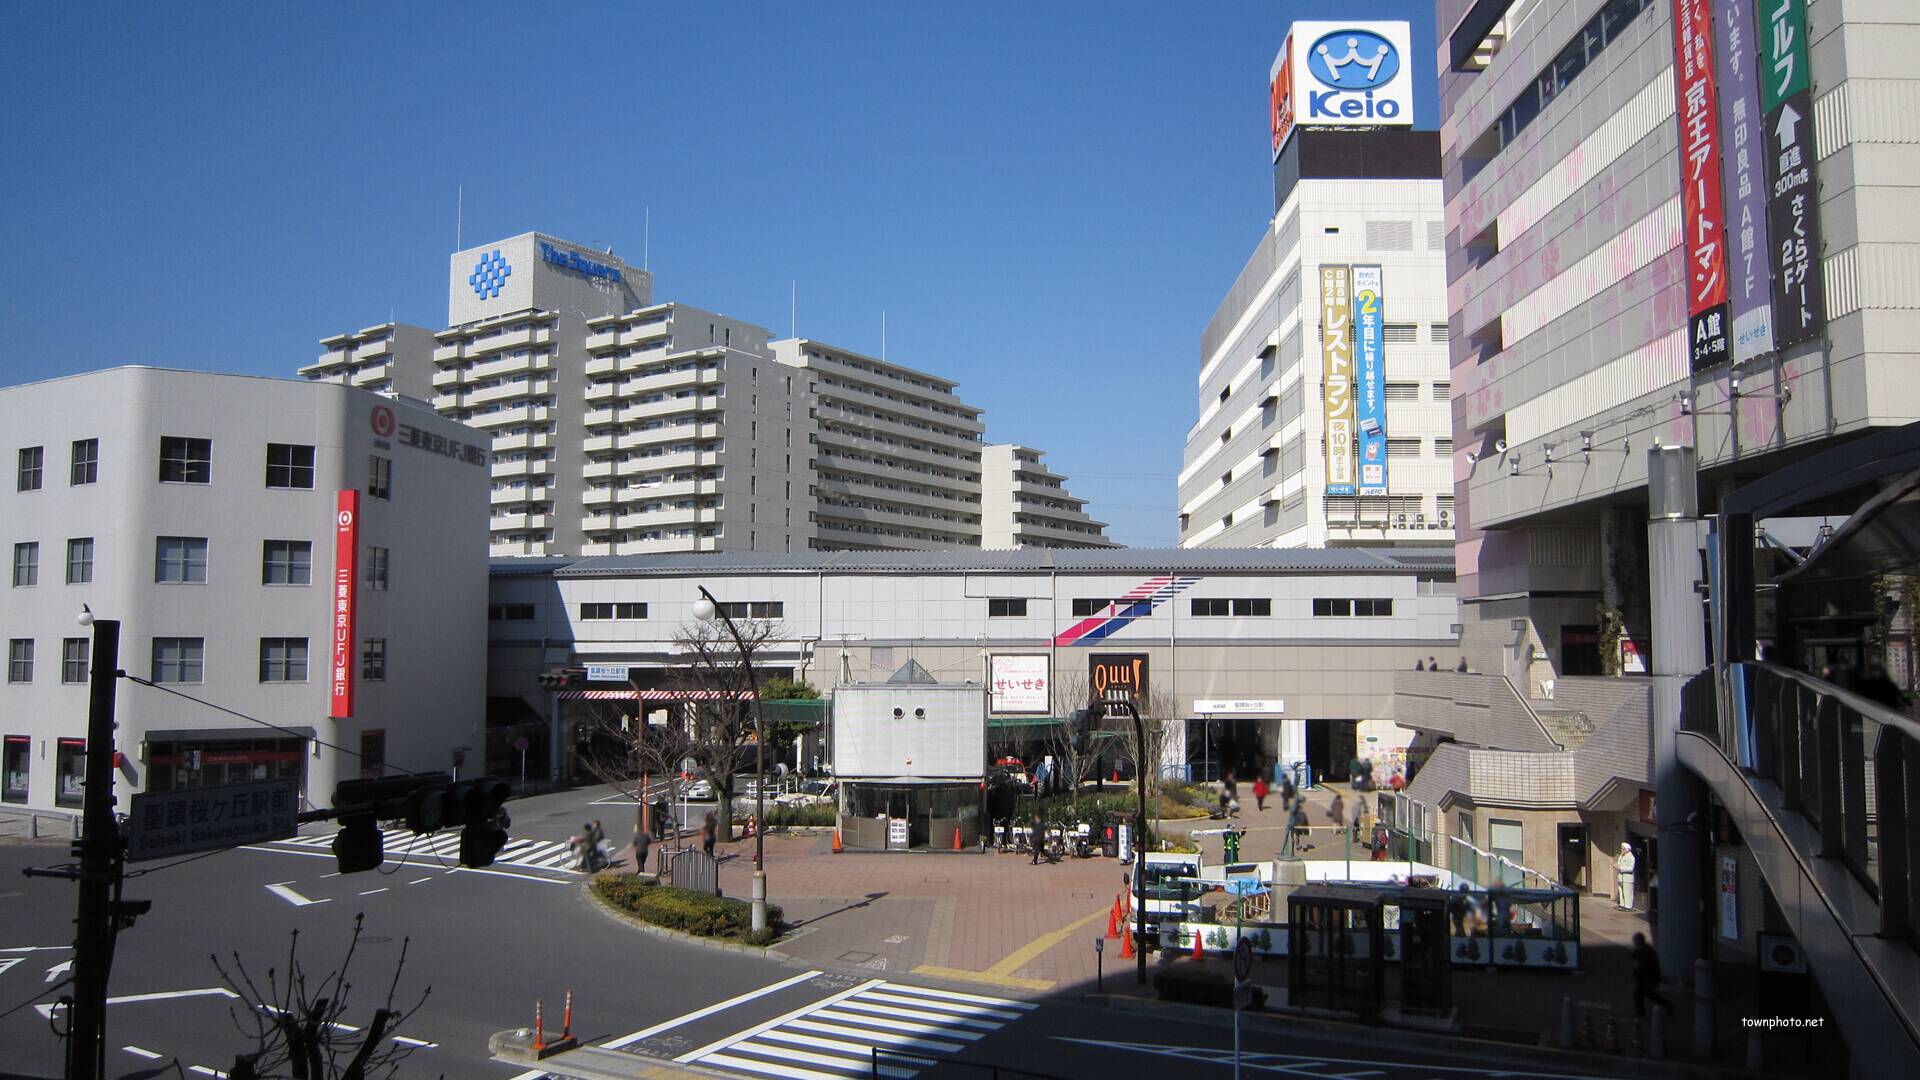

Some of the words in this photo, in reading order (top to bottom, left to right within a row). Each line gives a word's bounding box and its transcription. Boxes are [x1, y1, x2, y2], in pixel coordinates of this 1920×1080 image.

[1693, 0, 1702, 21] く
[1727, 0, 1743, 82] います。
[1309, 90, 1400, 118] Keio
[1733, 97, 1751, 200] 無印良品
[1779, 145, 1801, 176] 直進
[1685, 77, 1717, 302] 京王アートマン
[1782, 239, 1794, 294] 2F
[1791, 194, 1812, 328] さくらゲート
[1696, 312, 1720, 344] A館
[1327, 307, 1348, 417] レストラン
[335, 569, 349, 696] 三菱東京UFJ銀行
[995, 678, 1046, 690] せいせき
[139, 827, 186, 850] Seiseki
